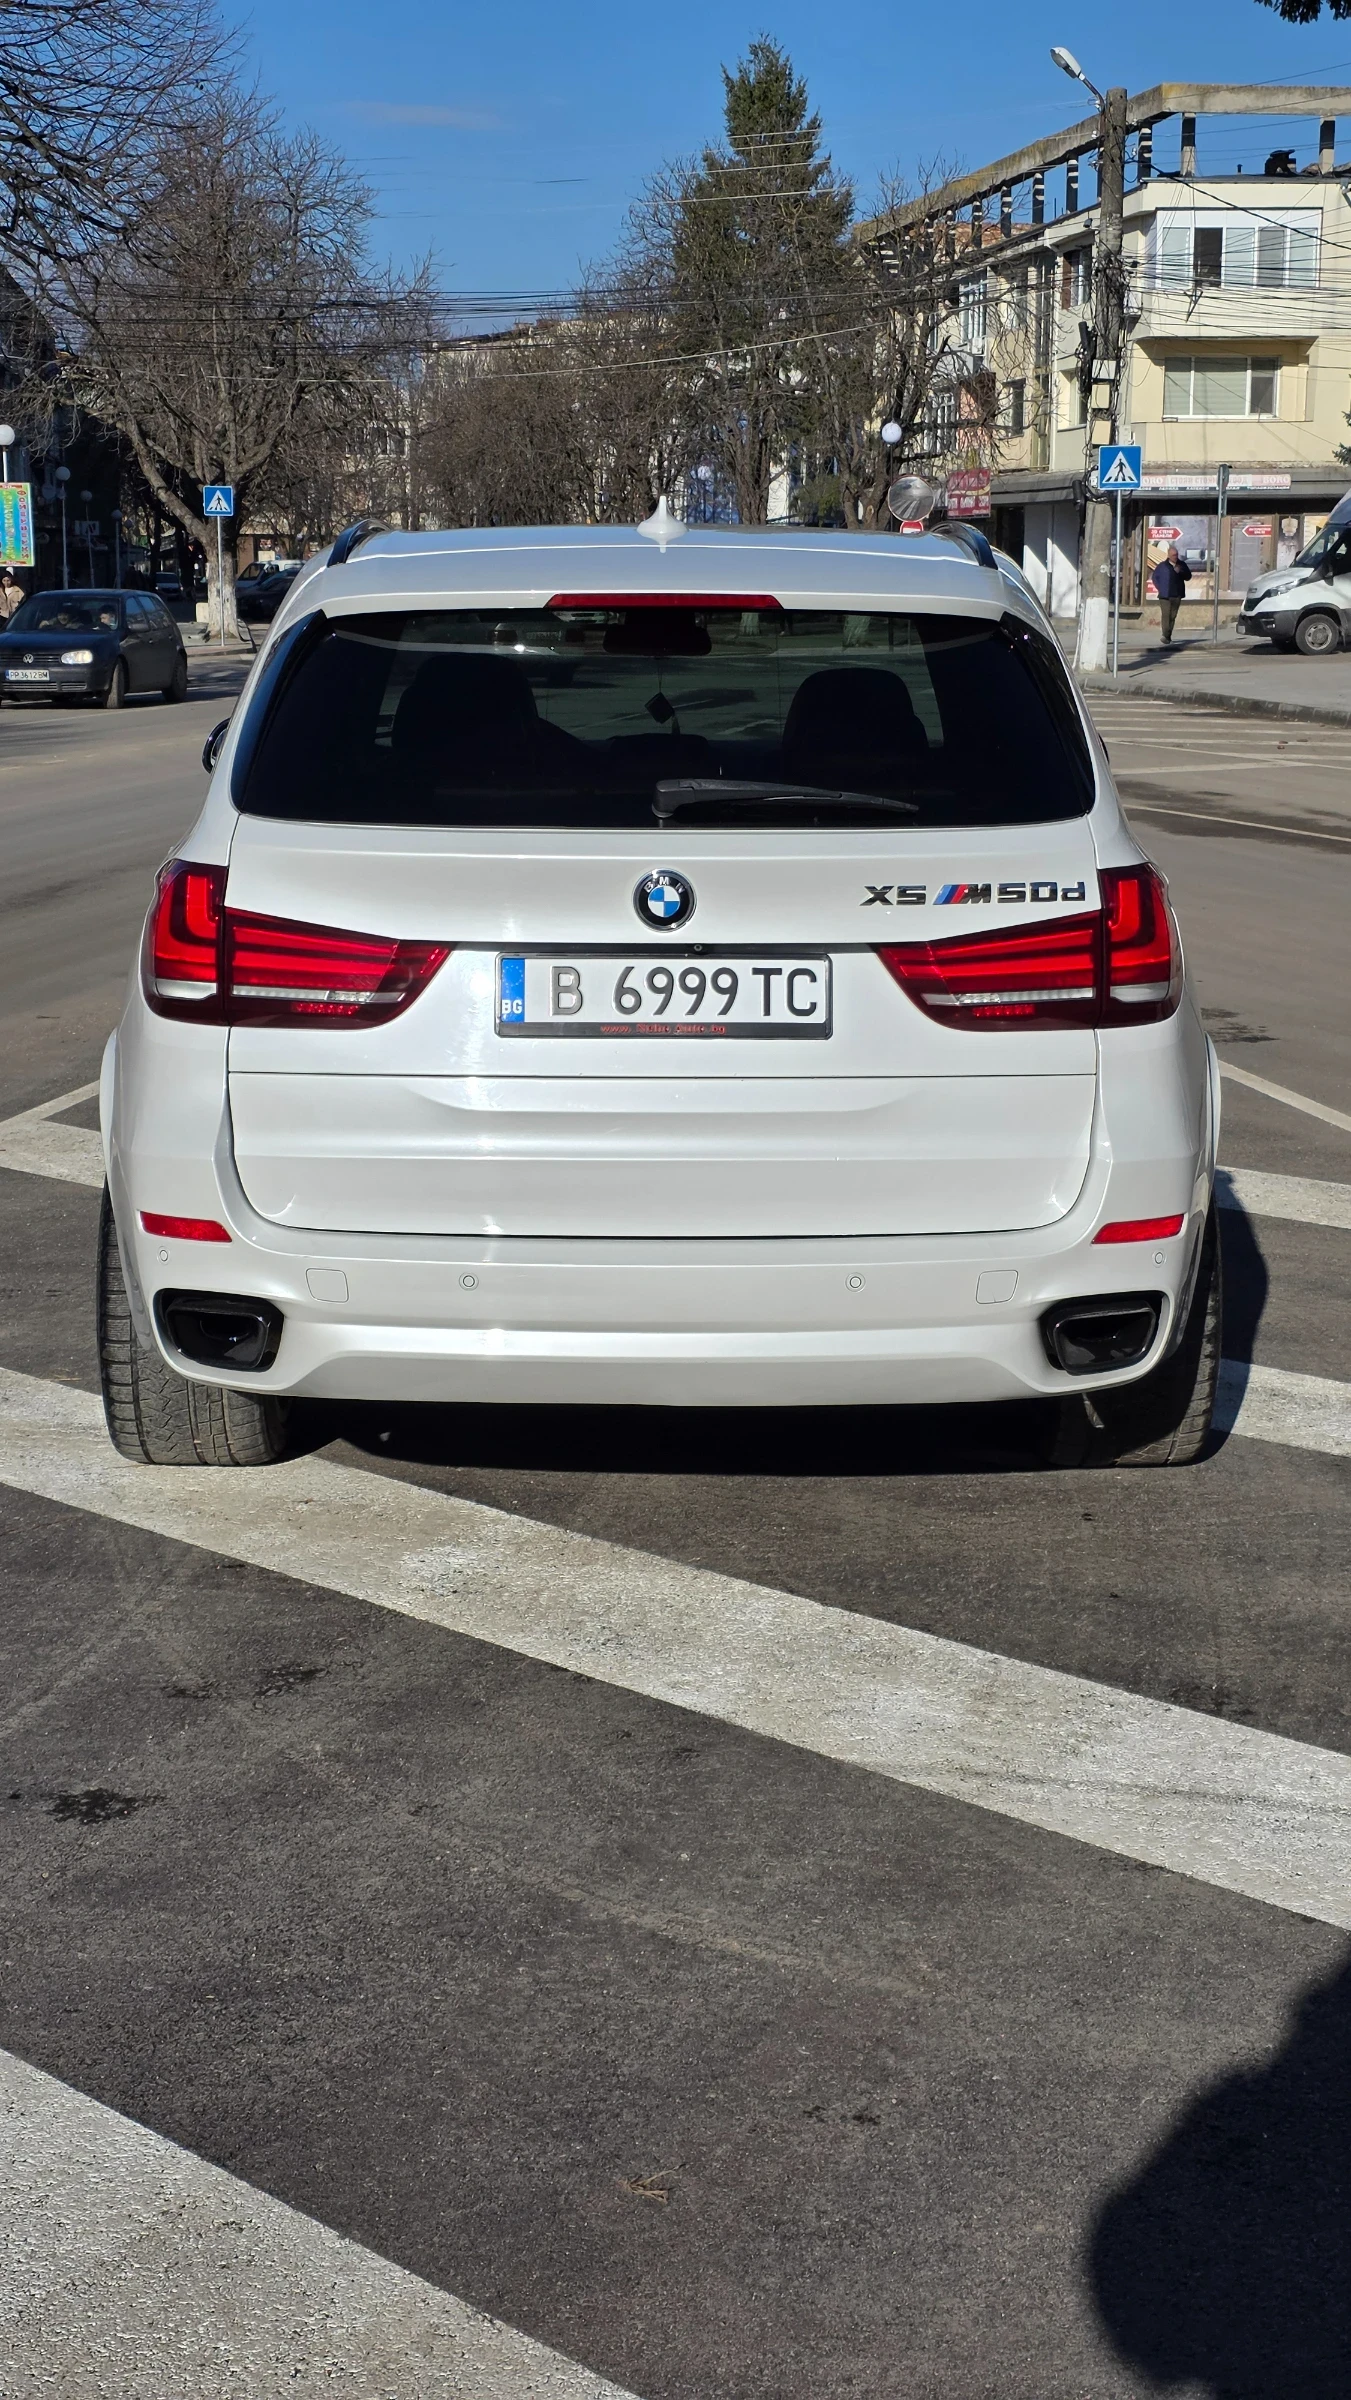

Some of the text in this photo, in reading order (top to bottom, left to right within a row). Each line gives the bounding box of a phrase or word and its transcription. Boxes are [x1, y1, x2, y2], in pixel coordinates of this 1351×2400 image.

[1142, 477, 1164, 488] ORO
[643, 876, 685, 893] BMW
[859, 885, 926, 906] X5
[551, 966, 818, 1017] B 6999 TC
[501, 999, 523, 1014] BG
